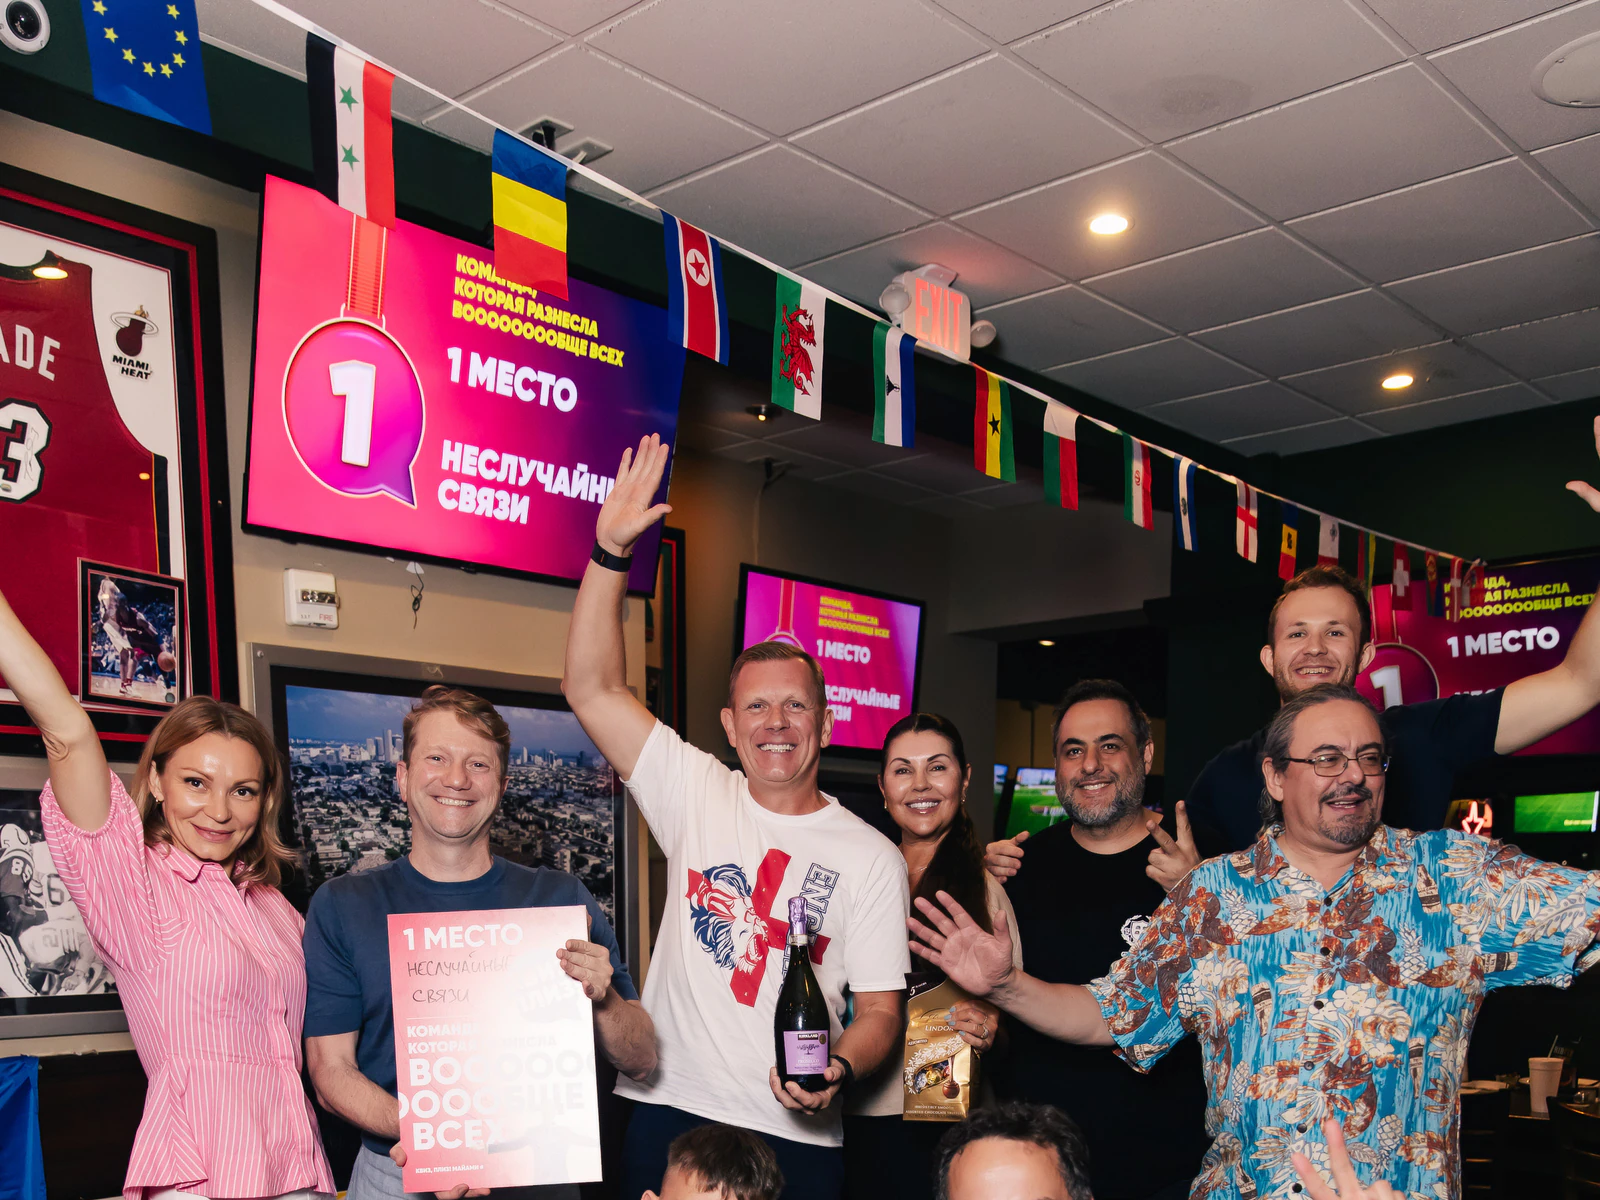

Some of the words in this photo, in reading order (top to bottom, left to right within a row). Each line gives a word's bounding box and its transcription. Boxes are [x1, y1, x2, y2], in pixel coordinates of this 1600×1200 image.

[454, 276, 525, 315] КОТОРАЯ
[526, 299, 599, 338] РАЗНЕСЛА
[915, 277, 963, 354] EXIT
[112, 354, 150, 371] MIAMI
[588, 343, 625, 367] ВСЕХ
[120, 366, 152, 380] HEAT
[447, 346, 462, 383] 1
[467, 354, 578, 413] МЕСТО
[328, 359, 377, 468] 1
[437, 477, 530, 525] СВЯЗИ
[1503, 582, 1570, 601] РАЗНЕСЛА
[319, 613, 334, 622] FIRE
[816, 638, 825, 657] 1
[825, 640, 871, 664] МЕСТО
[1446, 636, 1459, 658] 1
[1465, 626, 1560, 657] МЕСТО
[403, 927, 415, 951] 1
[424, 923, 524, 950] МЕСТО
[412, 988, 470, 1004] СВЯЗИ
